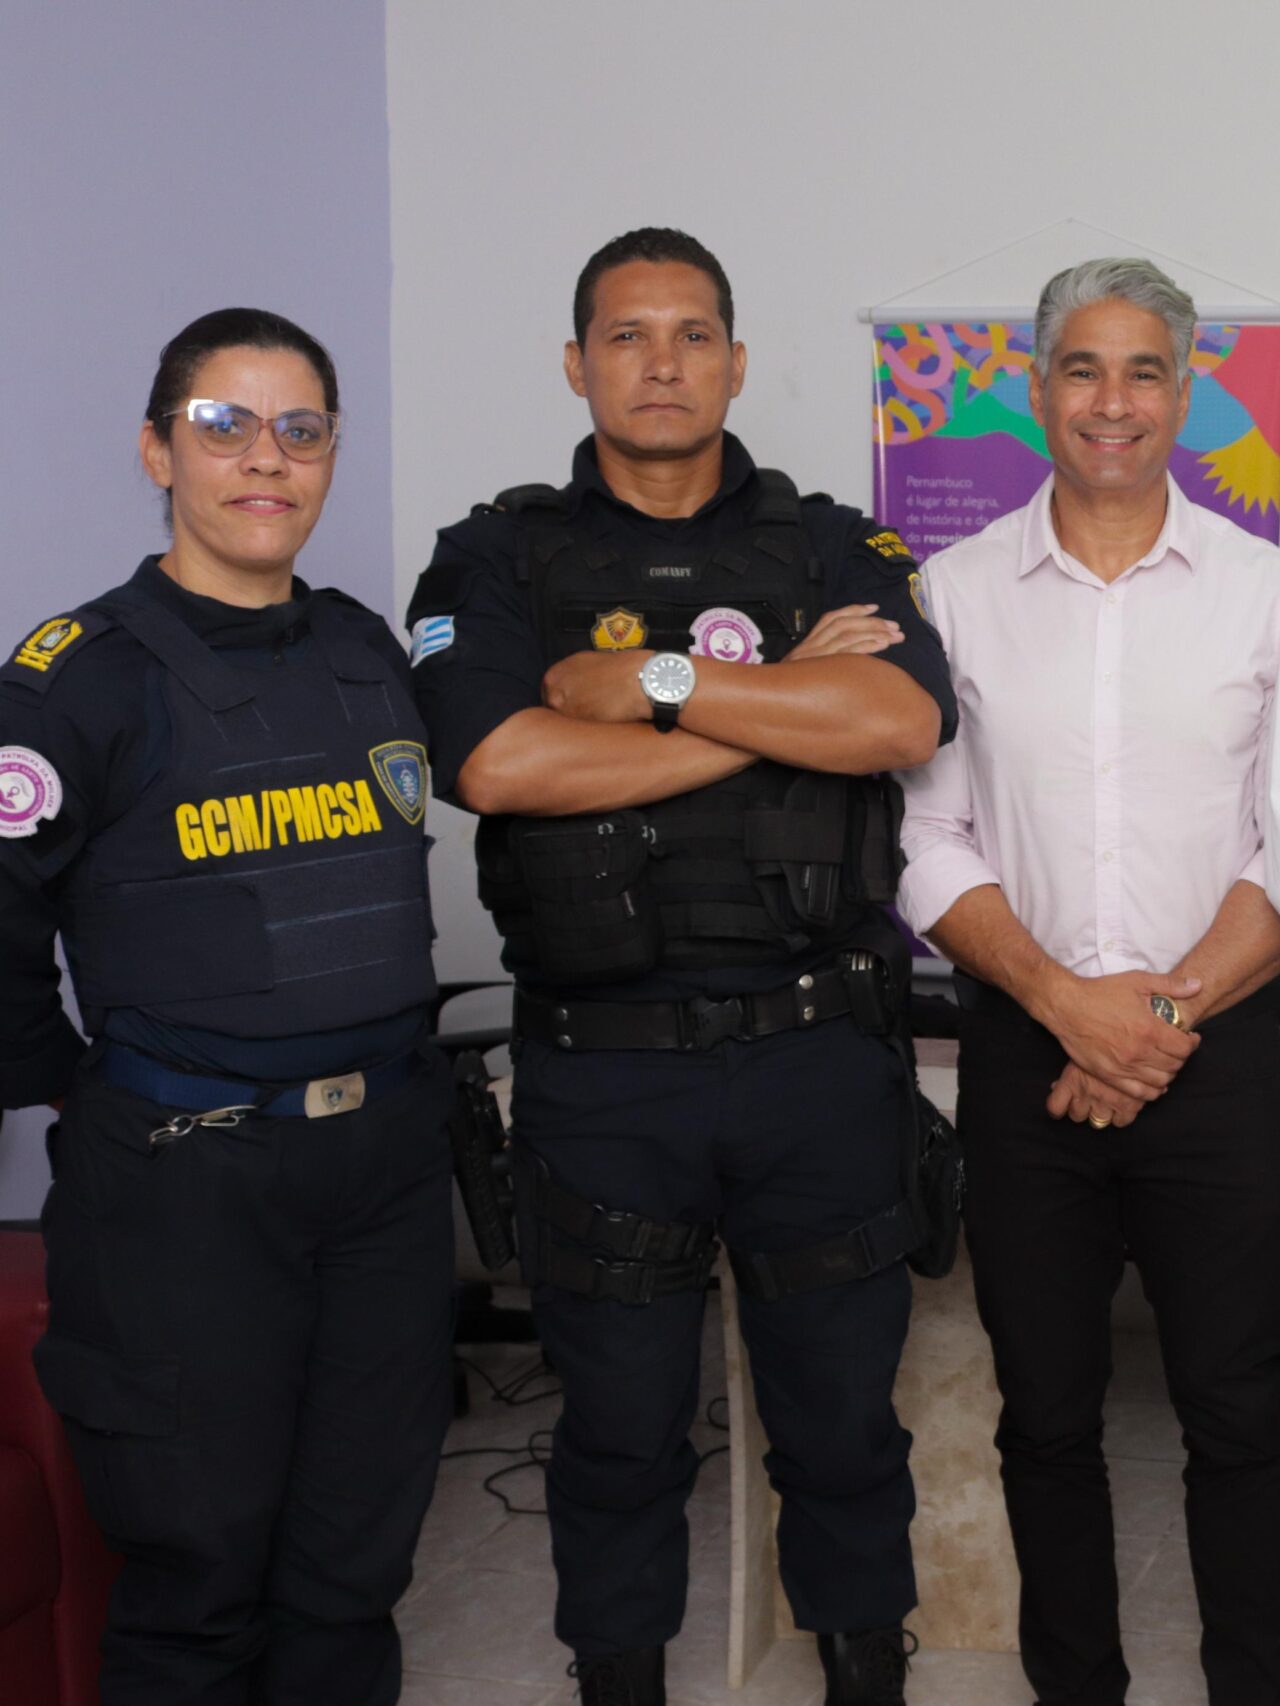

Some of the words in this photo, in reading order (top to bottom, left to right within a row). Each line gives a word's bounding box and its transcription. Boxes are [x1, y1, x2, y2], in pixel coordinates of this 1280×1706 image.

[906, 475, 973, 488] Pernambuco
[906, 495, 913, 507] é
[916, 495, 942, 510] lugar
[944, 495, 960, 507] de
[906, 514, 920, 526] de
[922, 514, 962, 526] história
[965, 517, 972, 526] e
[923, 532, 965, 547] respeit
[175, 779, 383, 861] GCM/PMCSA
